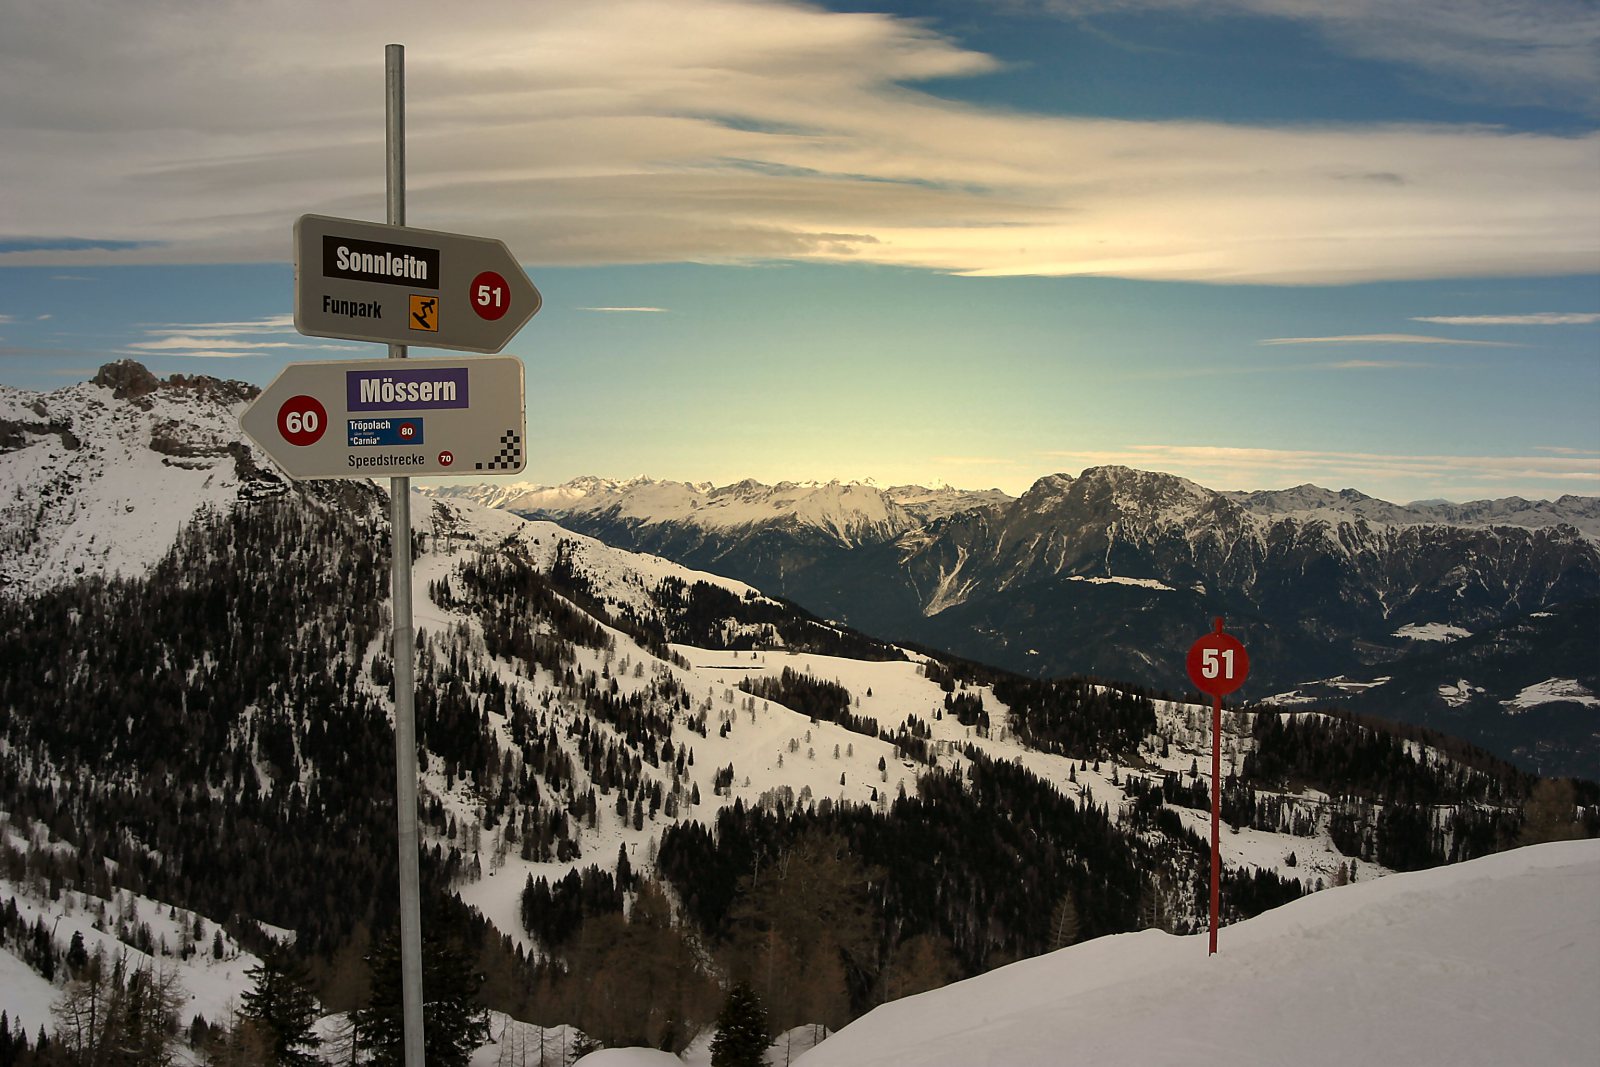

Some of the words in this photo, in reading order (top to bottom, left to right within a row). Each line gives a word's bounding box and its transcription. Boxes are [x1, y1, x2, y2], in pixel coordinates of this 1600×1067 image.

[336, 246, 427, 280] Sonnleitn
[323, 295, 382, 319] Funpark
[477, 285, 502, 307] 51
[360, 377, 456, 403] Mössern
[285, 411, 318, 434] 60
[349, 420, 391, 431] Tröpolach
[401, 427, 413, 436] 80
[348, 454, 425, 468] Speedstrecke
[440, 455, 452, 463] 70
[1201, 648, 1234, 679] 51
